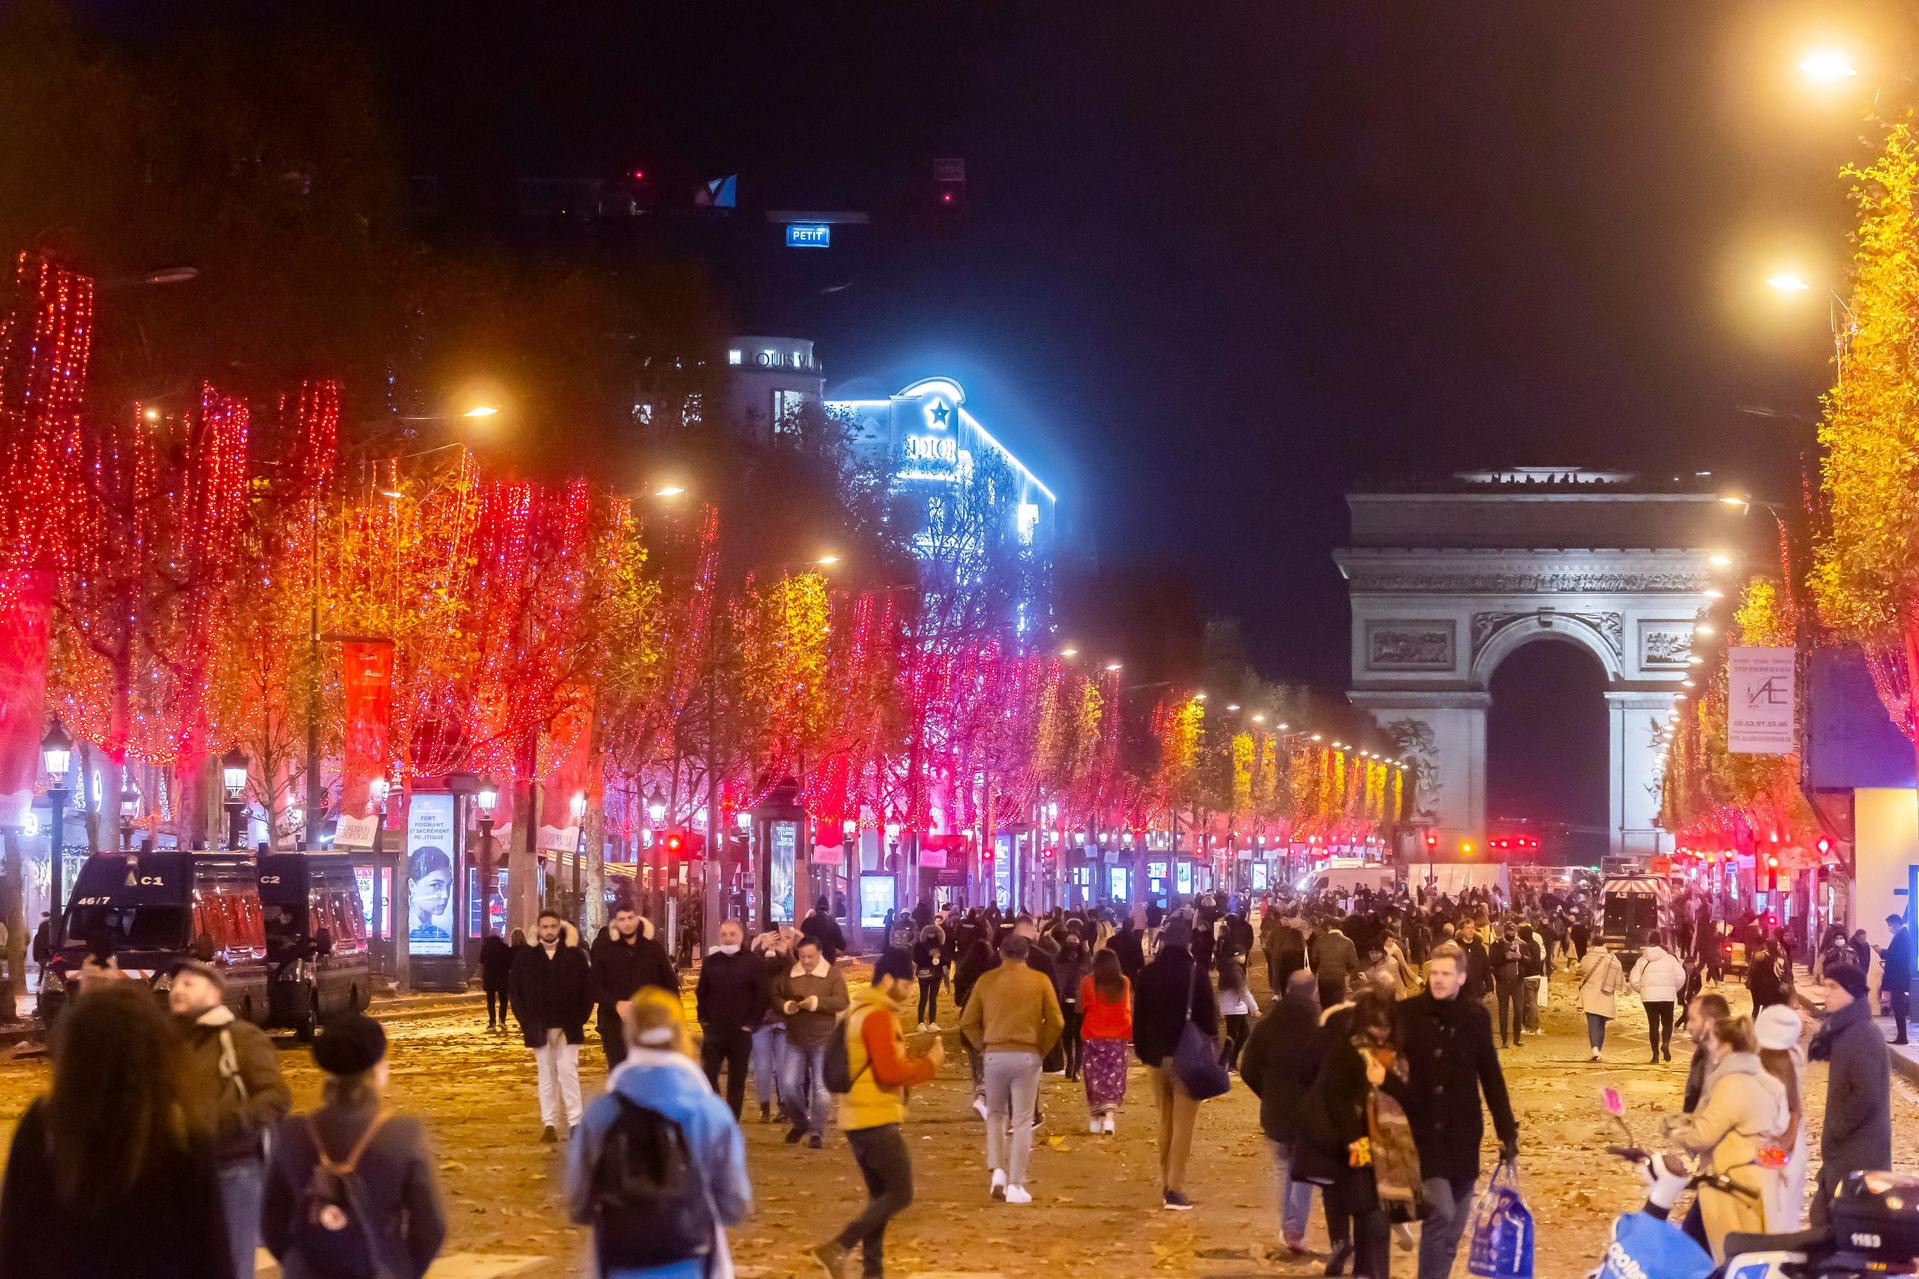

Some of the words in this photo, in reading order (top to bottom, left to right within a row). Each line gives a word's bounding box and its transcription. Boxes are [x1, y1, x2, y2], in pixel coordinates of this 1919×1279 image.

[793, 231, 823, 241] PETIT
[140, 876, 164, 886] C1
[260, 875, 281, 884] C2
[78, 897, 111, 905] 46/7
